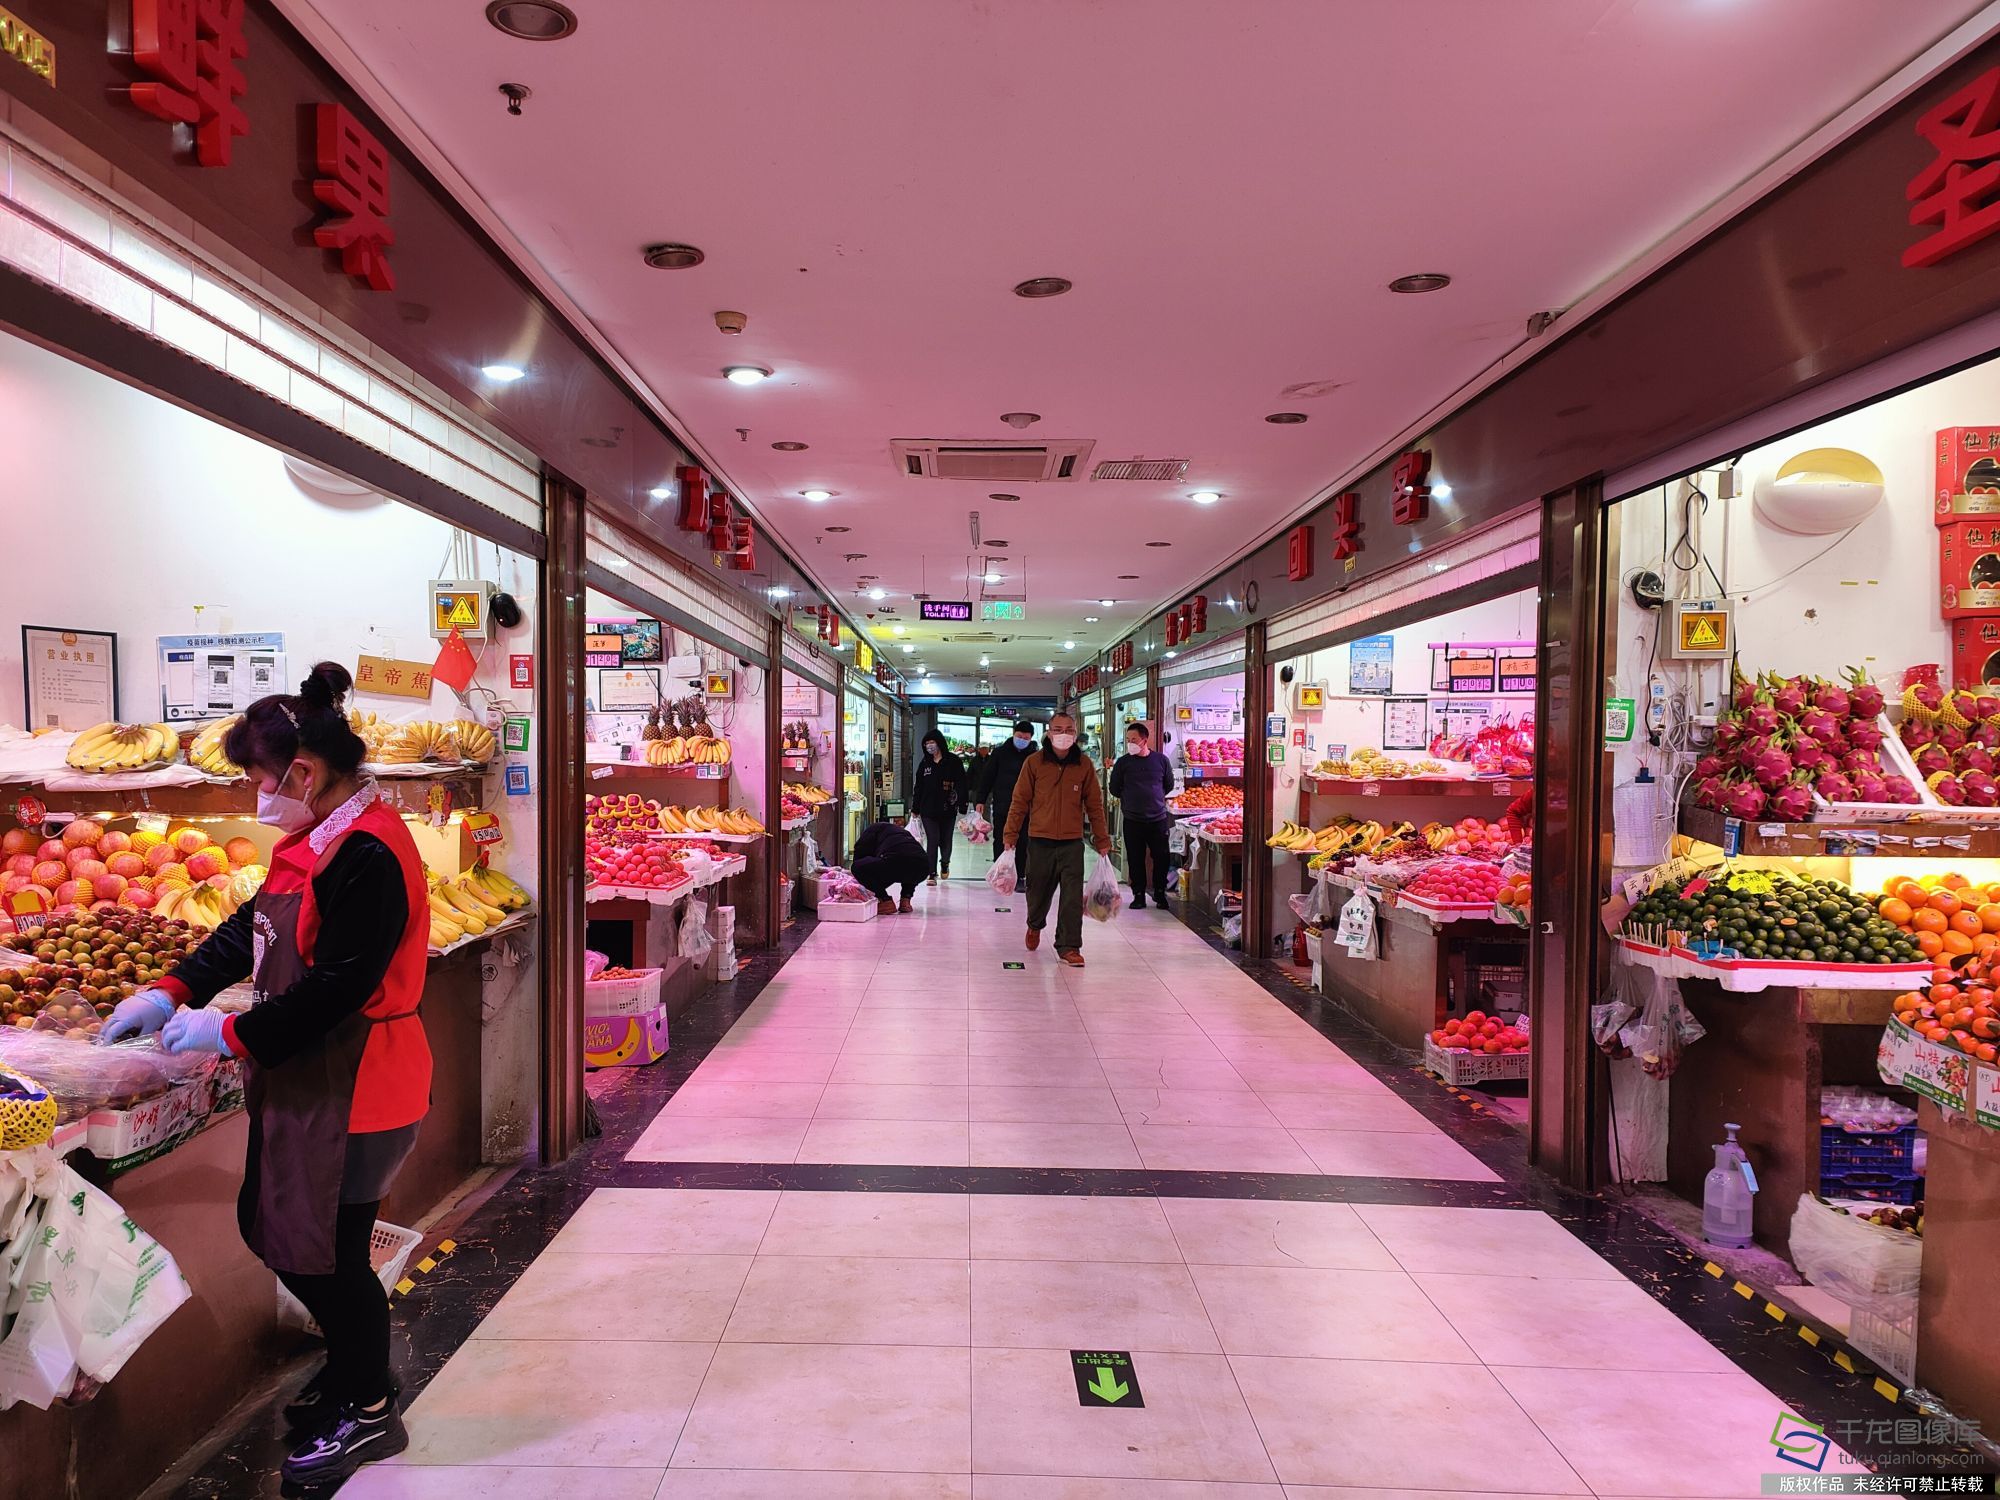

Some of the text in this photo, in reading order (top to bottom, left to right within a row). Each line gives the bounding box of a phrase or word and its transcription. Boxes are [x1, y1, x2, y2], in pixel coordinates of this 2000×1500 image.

[1289, 450, 1424, 582] 回头客
[47, 649, 95, 663] 营业执照
[358, 663, 428, 690] 皇帝蕉
[1077, 1358, 1127, 1366] 安全出口
